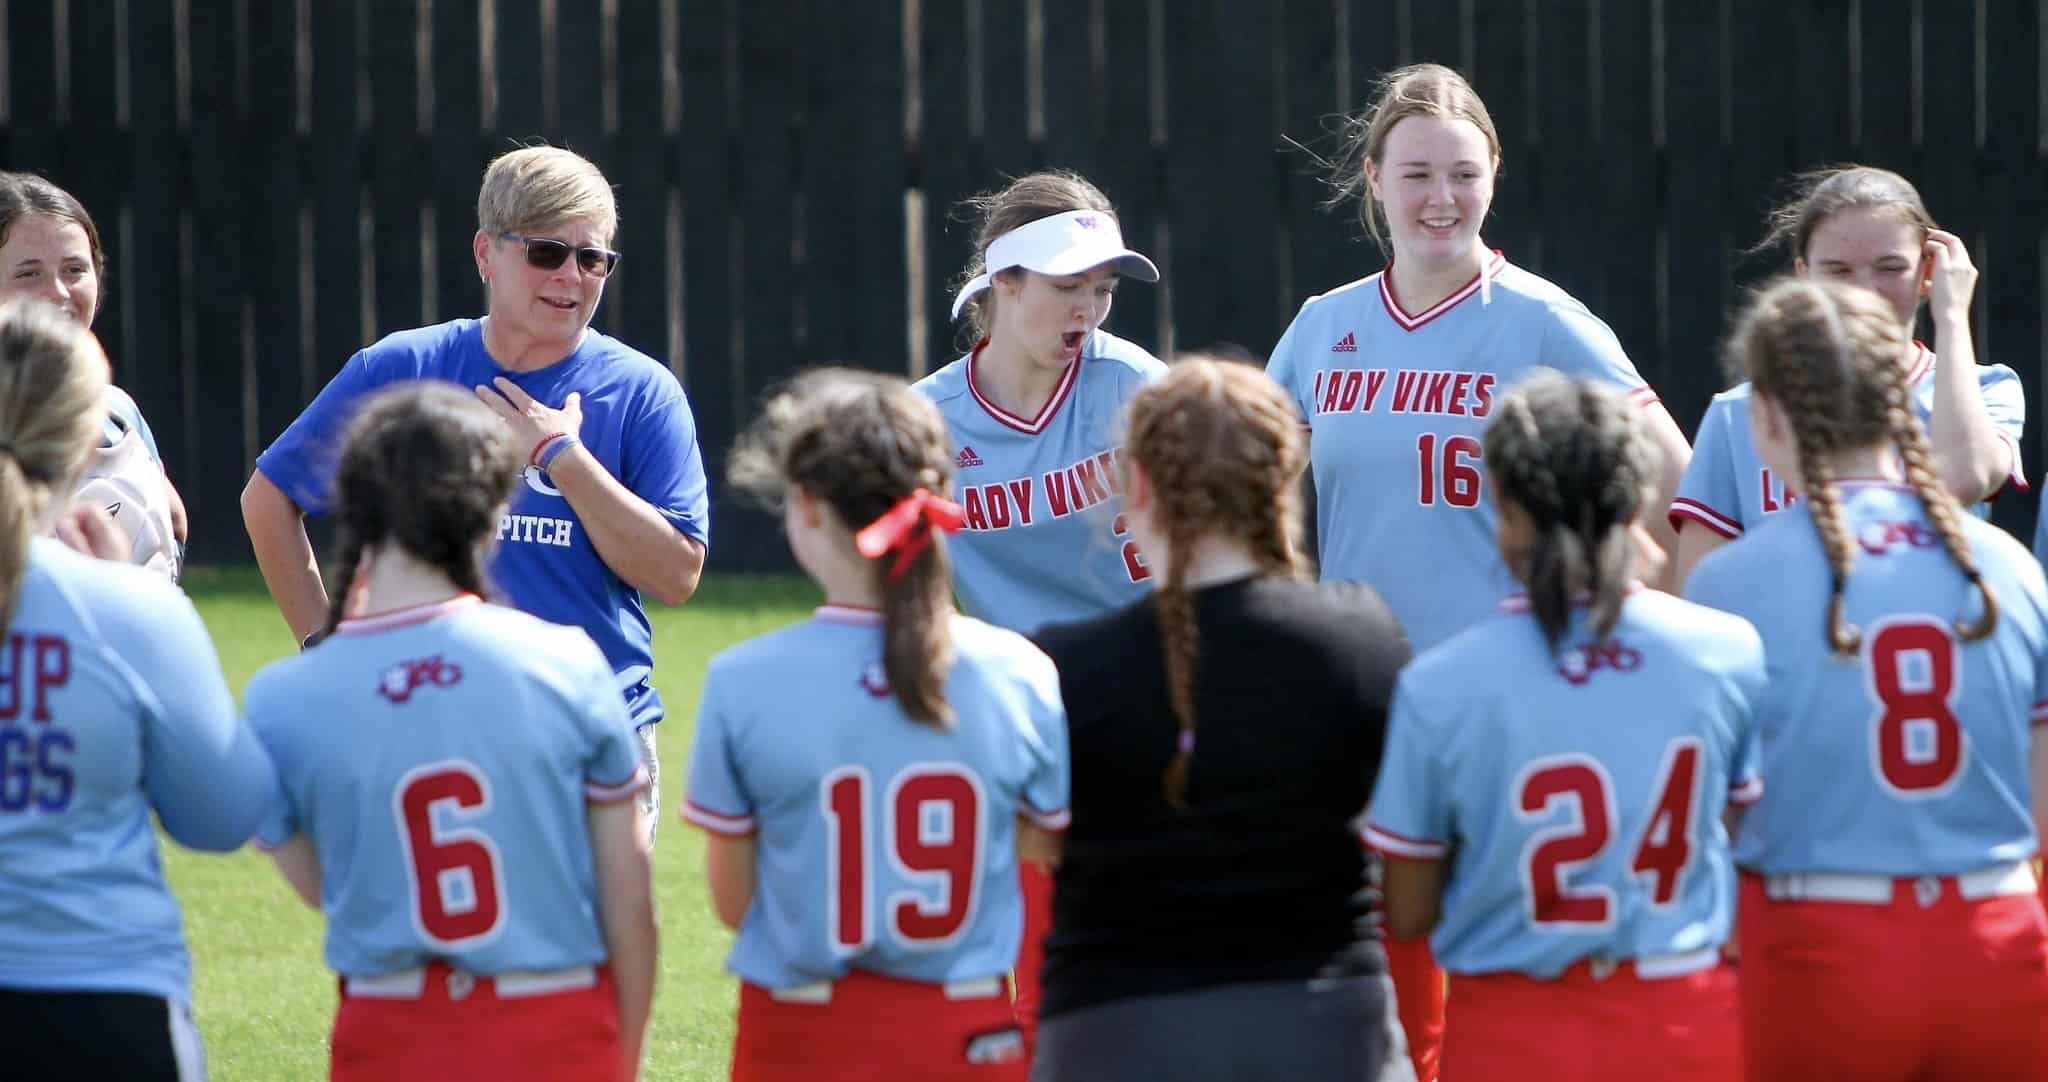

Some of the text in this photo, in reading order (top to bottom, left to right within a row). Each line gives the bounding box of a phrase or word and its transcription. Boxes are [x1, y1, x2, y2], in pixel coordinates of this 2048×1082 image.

[1391, 369, 1496, 419] VIKES
[495, 514, 573, 547] PITCH
[951, 476, 1033, 532] ADY
[1416, 432, 1484, 508] 16
[1862, 613, 1970, 801] 8
[391, 757, 509, 951] 6
[819, 761, 989, 957] 19
[1511, 731, 1705, 933] 24
